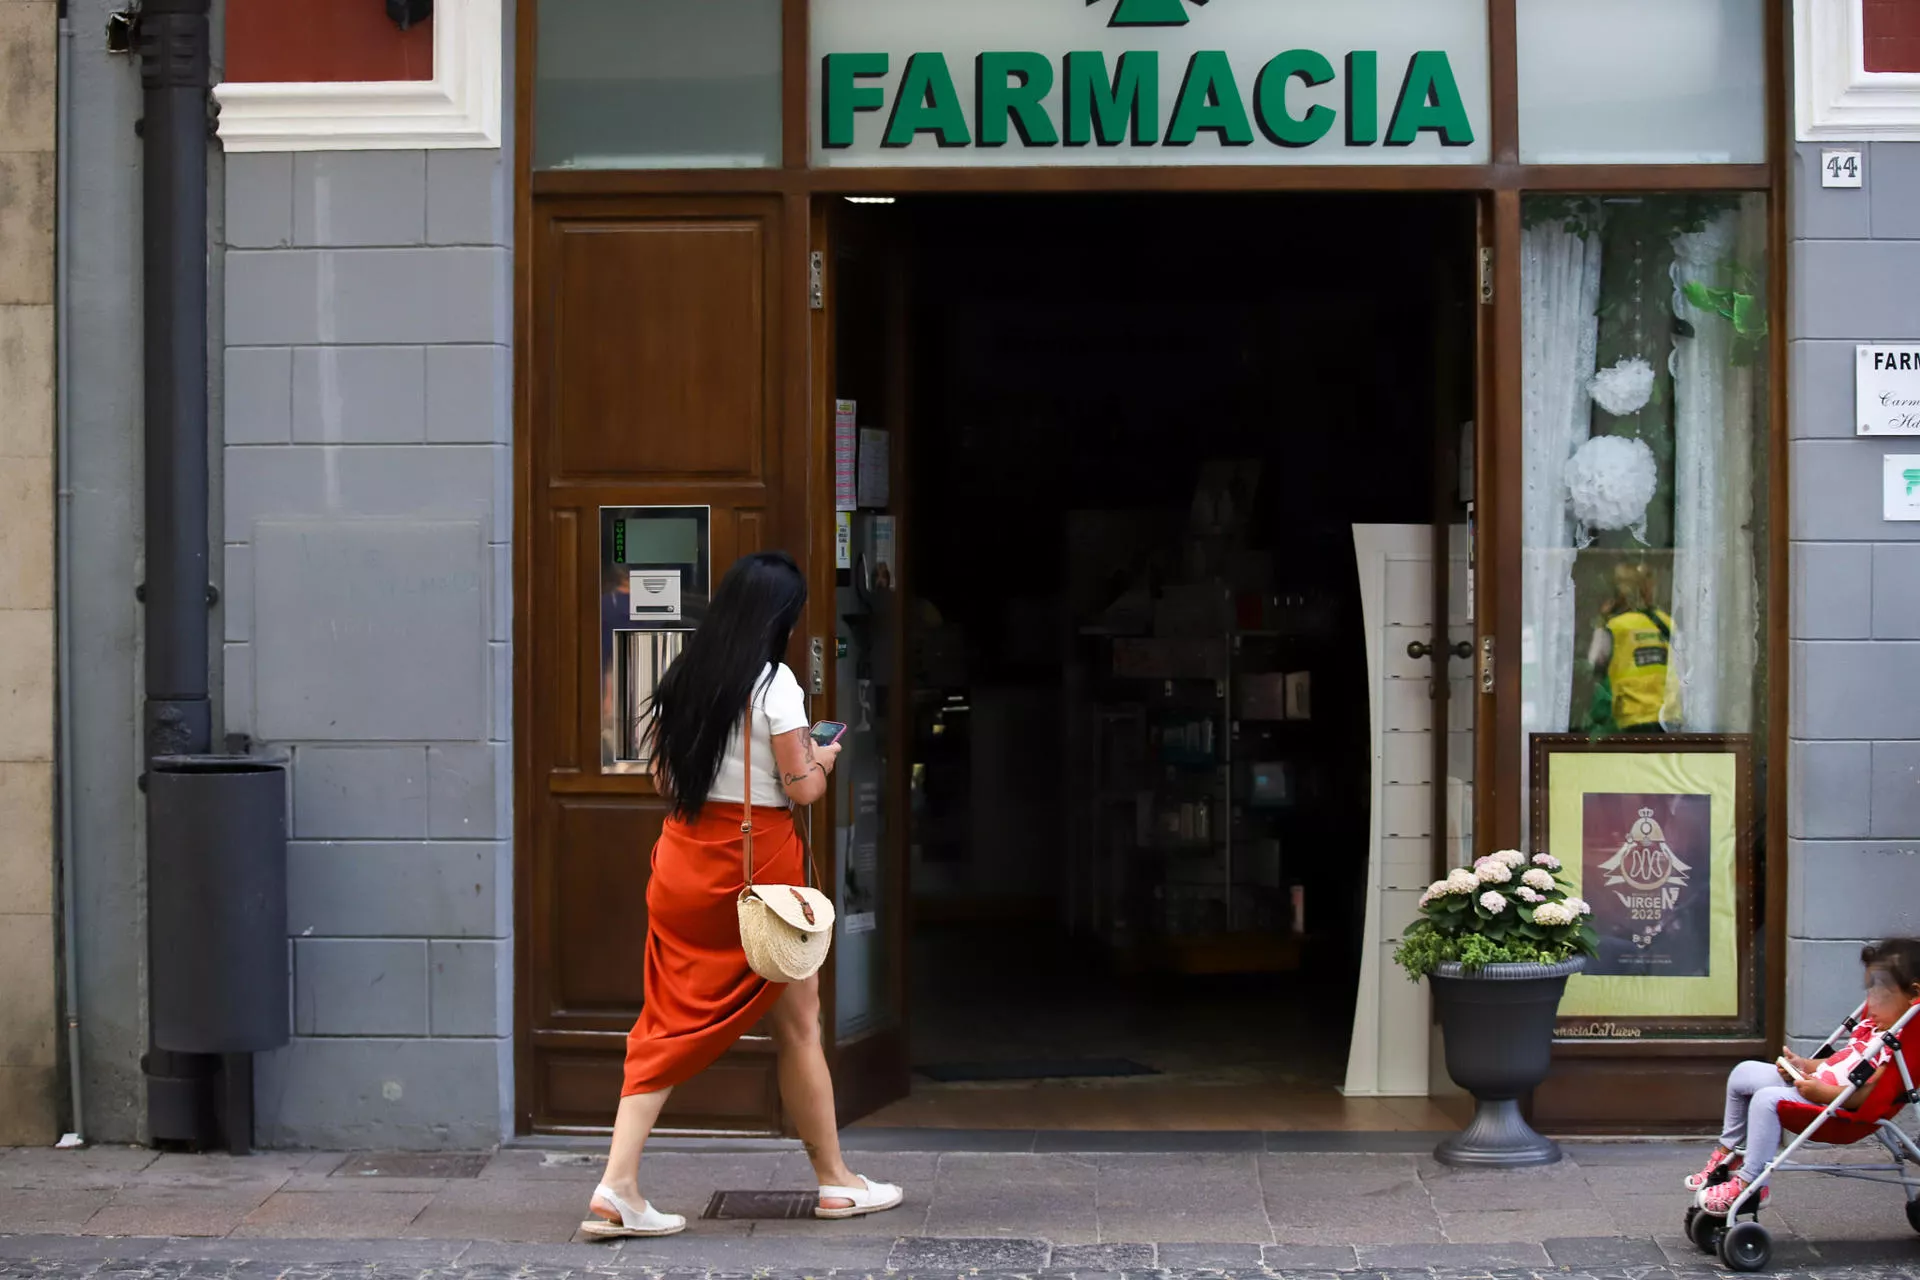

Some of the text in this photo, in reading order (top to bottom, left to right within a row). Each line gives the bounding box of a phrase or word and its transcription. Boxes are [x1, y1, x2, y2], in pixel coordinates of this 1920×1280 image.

[822, 48, 1475, 149] FARMACIA
[1826, 155, 1858, 178] 44
[1612, 887, 1680, 911] VIRGEN
[1631, 909, 1661, 920] 2025
